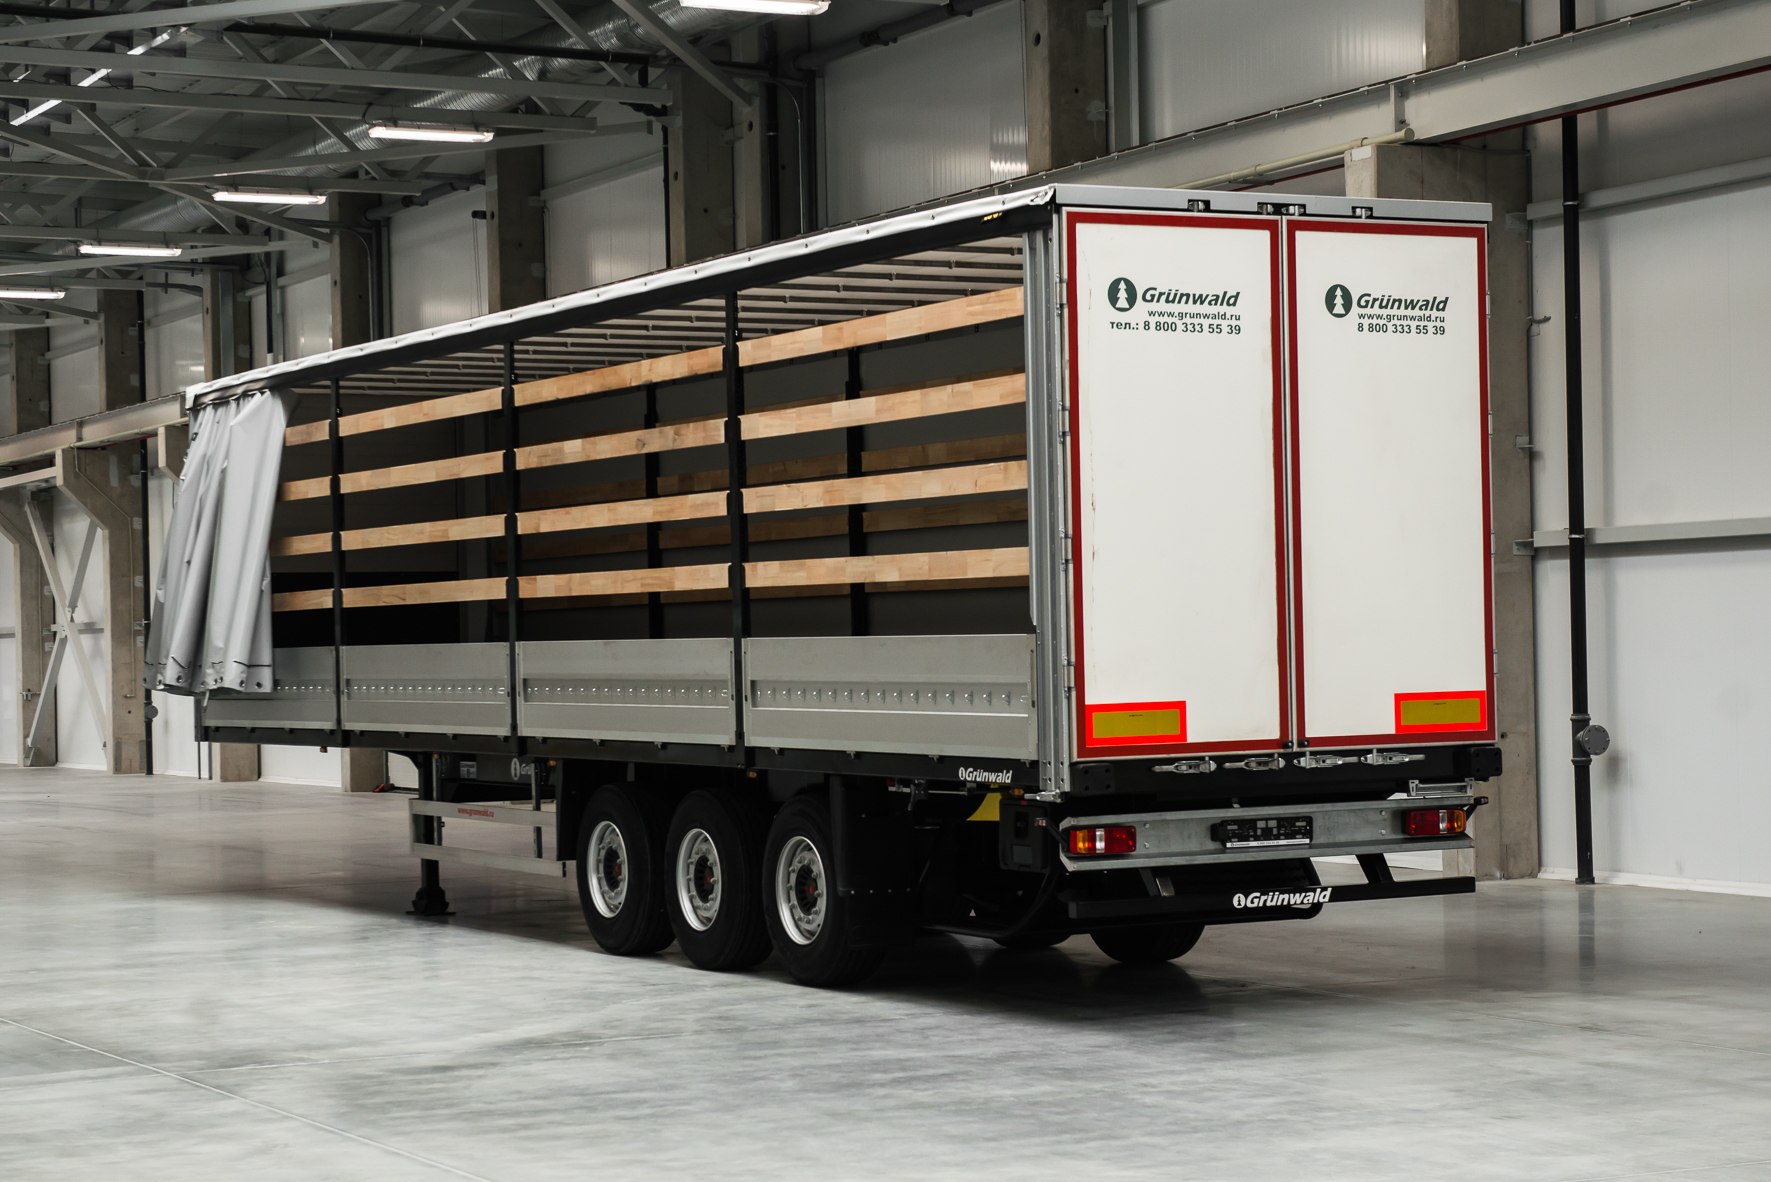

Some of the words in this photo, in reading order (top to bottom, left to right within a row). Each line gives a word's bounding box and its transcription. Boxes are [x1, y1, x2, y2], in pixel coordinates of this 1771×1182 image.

[1141, 287, 1240, 307] Grünwald
[1356, 293, 1449, 312] Grünwald
[1147, 310, 1241, 321] www.grunwald.ru
[1357, 313, 1445, 323] www.grunwald.ru
[1109, 321, 1139, 330] тел.:
[1143, 320, 1150, 331] 8
[1155, 321, 1177, 332] 800
[1181, 322, 1204, 333] 333
[1208, 323, 1222, 334] 55
[1226, 324, 1241, 335] 39
[1357, 322, 1364, 333] 8
[1368, 323, 1388, 333] 800
[1392, 324, 1411, 334] 333
[1415, 325, 1428, 335] 55
[1432, 325, 1445, 335] 39
[965, 767, 1013, 783] Grünwald
[1246, 887, 1332, 908] Grünwald
